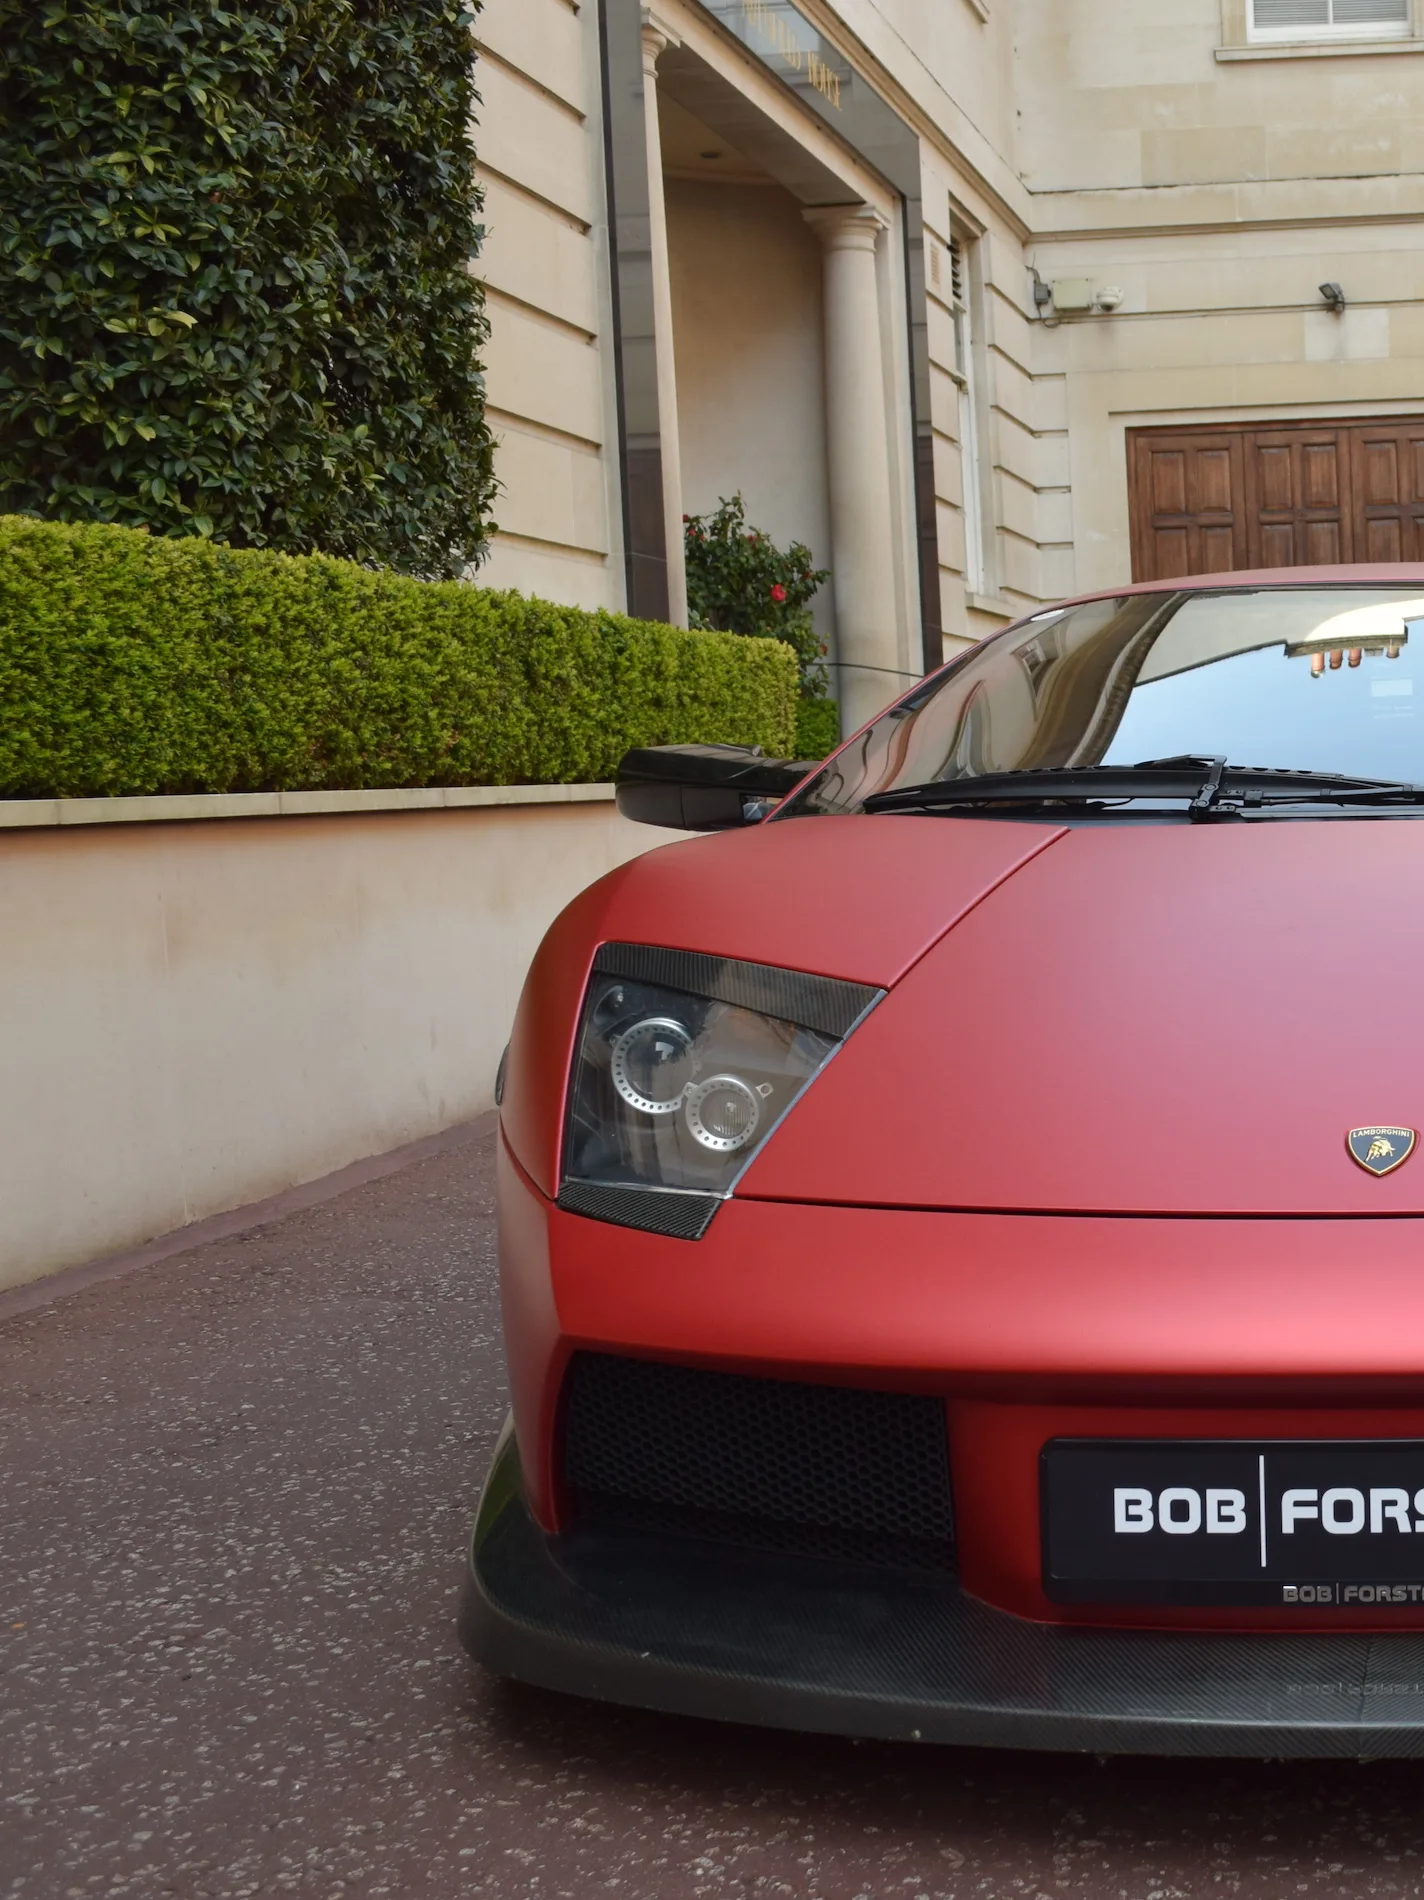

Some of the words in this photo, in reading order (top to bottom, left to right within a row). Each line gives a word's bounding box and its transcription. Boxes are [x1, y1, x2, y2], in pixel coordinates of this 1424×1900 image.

[1353, 1129, 1410, 1138] LAMBORGHINI
[1113, 1487, 1247, 1535] BOB
[1282, 1585, 1333, 1603] BOB
